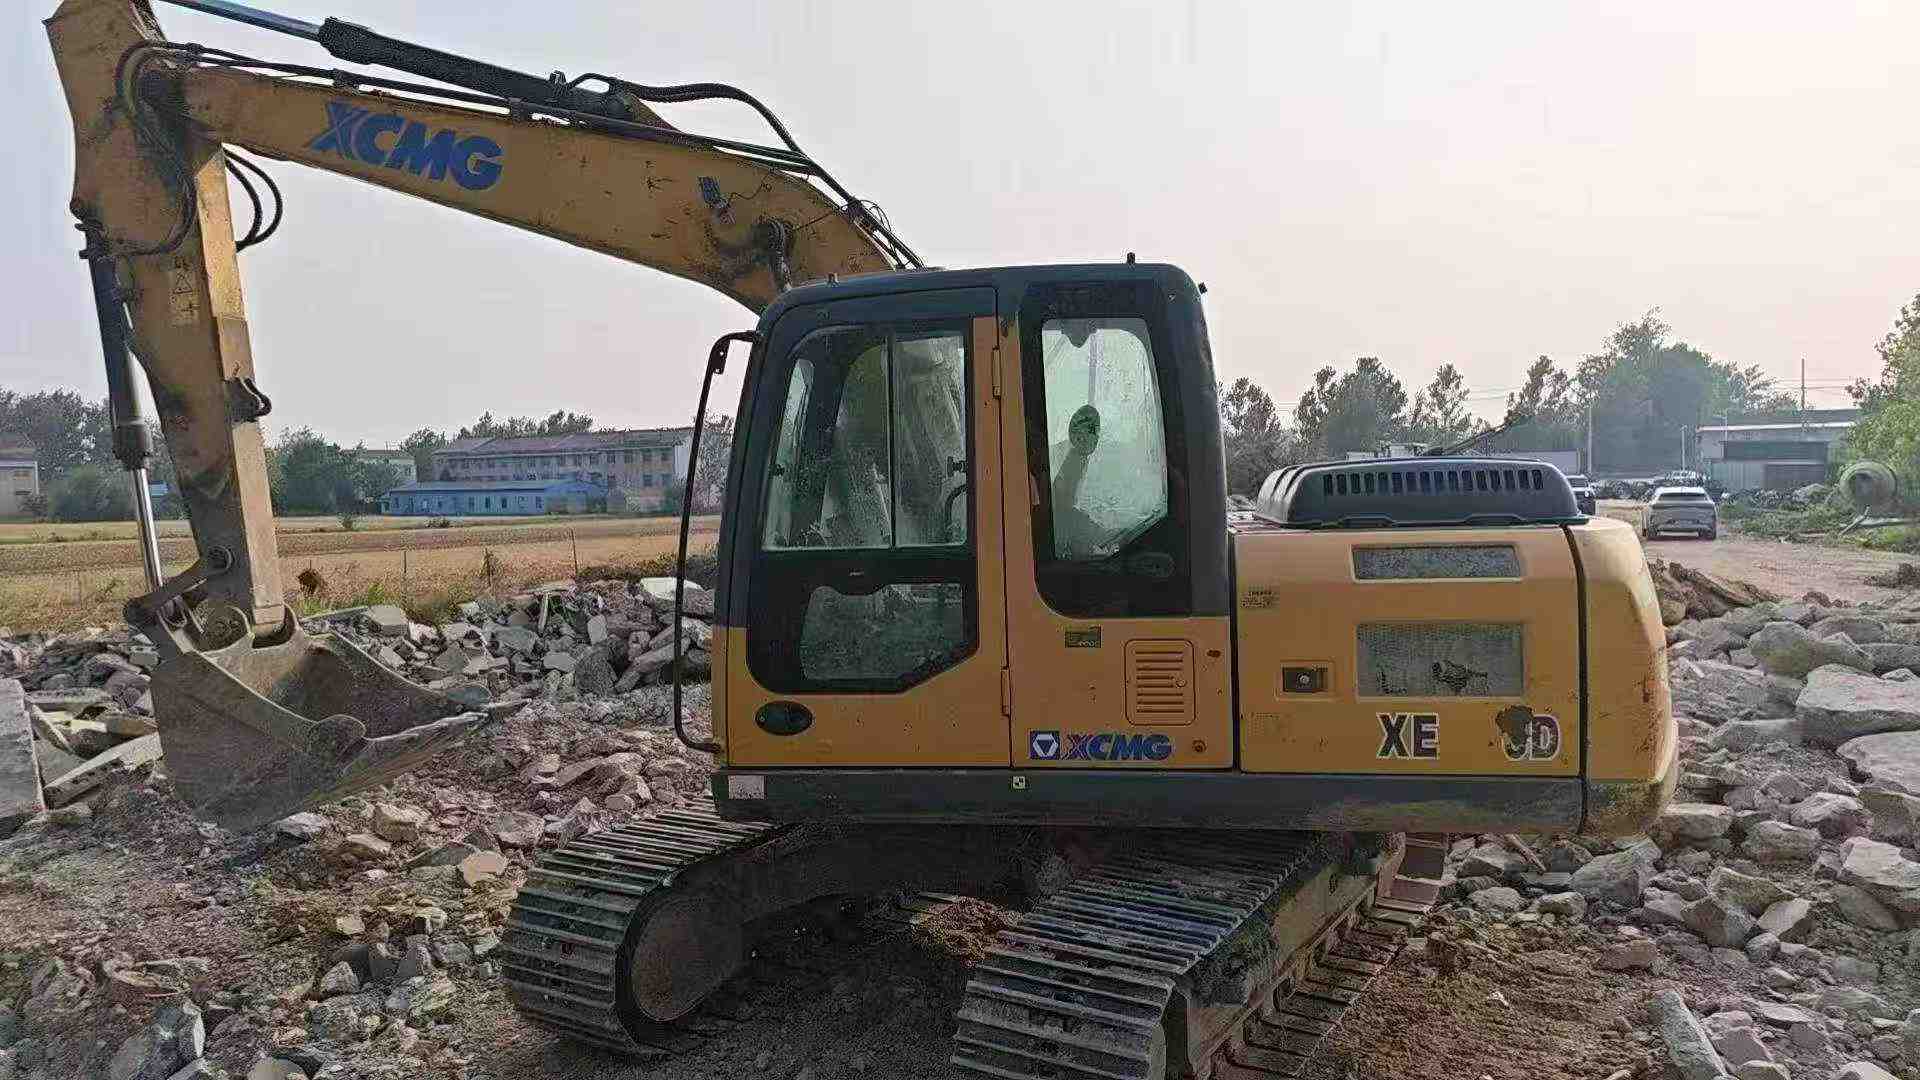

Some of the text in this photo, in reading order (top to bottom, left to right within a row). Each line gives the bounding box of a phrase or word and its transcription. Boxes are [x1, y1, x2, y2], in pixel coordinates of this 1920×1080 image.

[309, 99, 504, 191] XCMG
[1062, 734, 1173, 761] XCMG
[1376, 712, 1440, 760] XE
